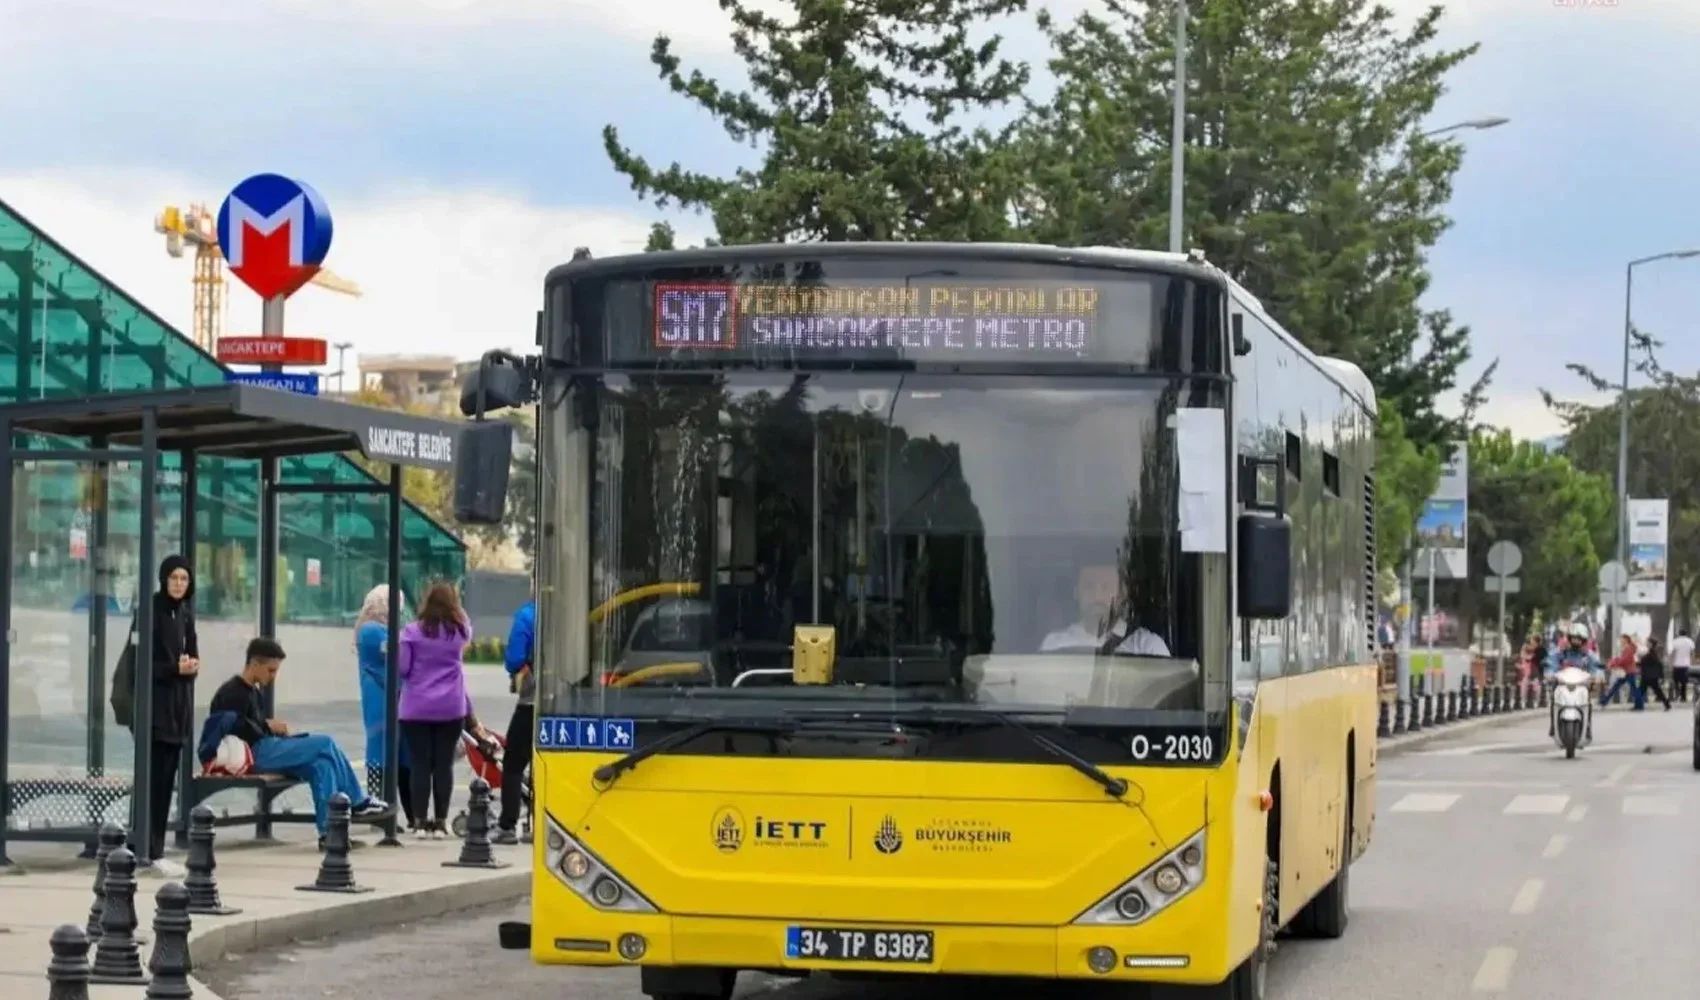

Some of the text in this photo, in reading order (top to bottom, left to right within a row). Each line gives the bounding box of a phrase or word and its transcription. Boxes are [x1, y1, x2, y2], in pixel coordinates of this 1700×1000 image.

[662, 291, 726, 341] SM7
[930, 287, 1098, 316] PERONLAR
[752, 316, 1085, 348] SANCAKTEPE METRO
[368, 425, 416, 458] SANCAKTEPE
[1131, 734, 1213, 759] O-2030
[755, 816, 827, 839] İETT
[915, 825, 1012, 844] BÜYÜKŞEHİR
[801, 930, 930, 961] 34 TP 6382
